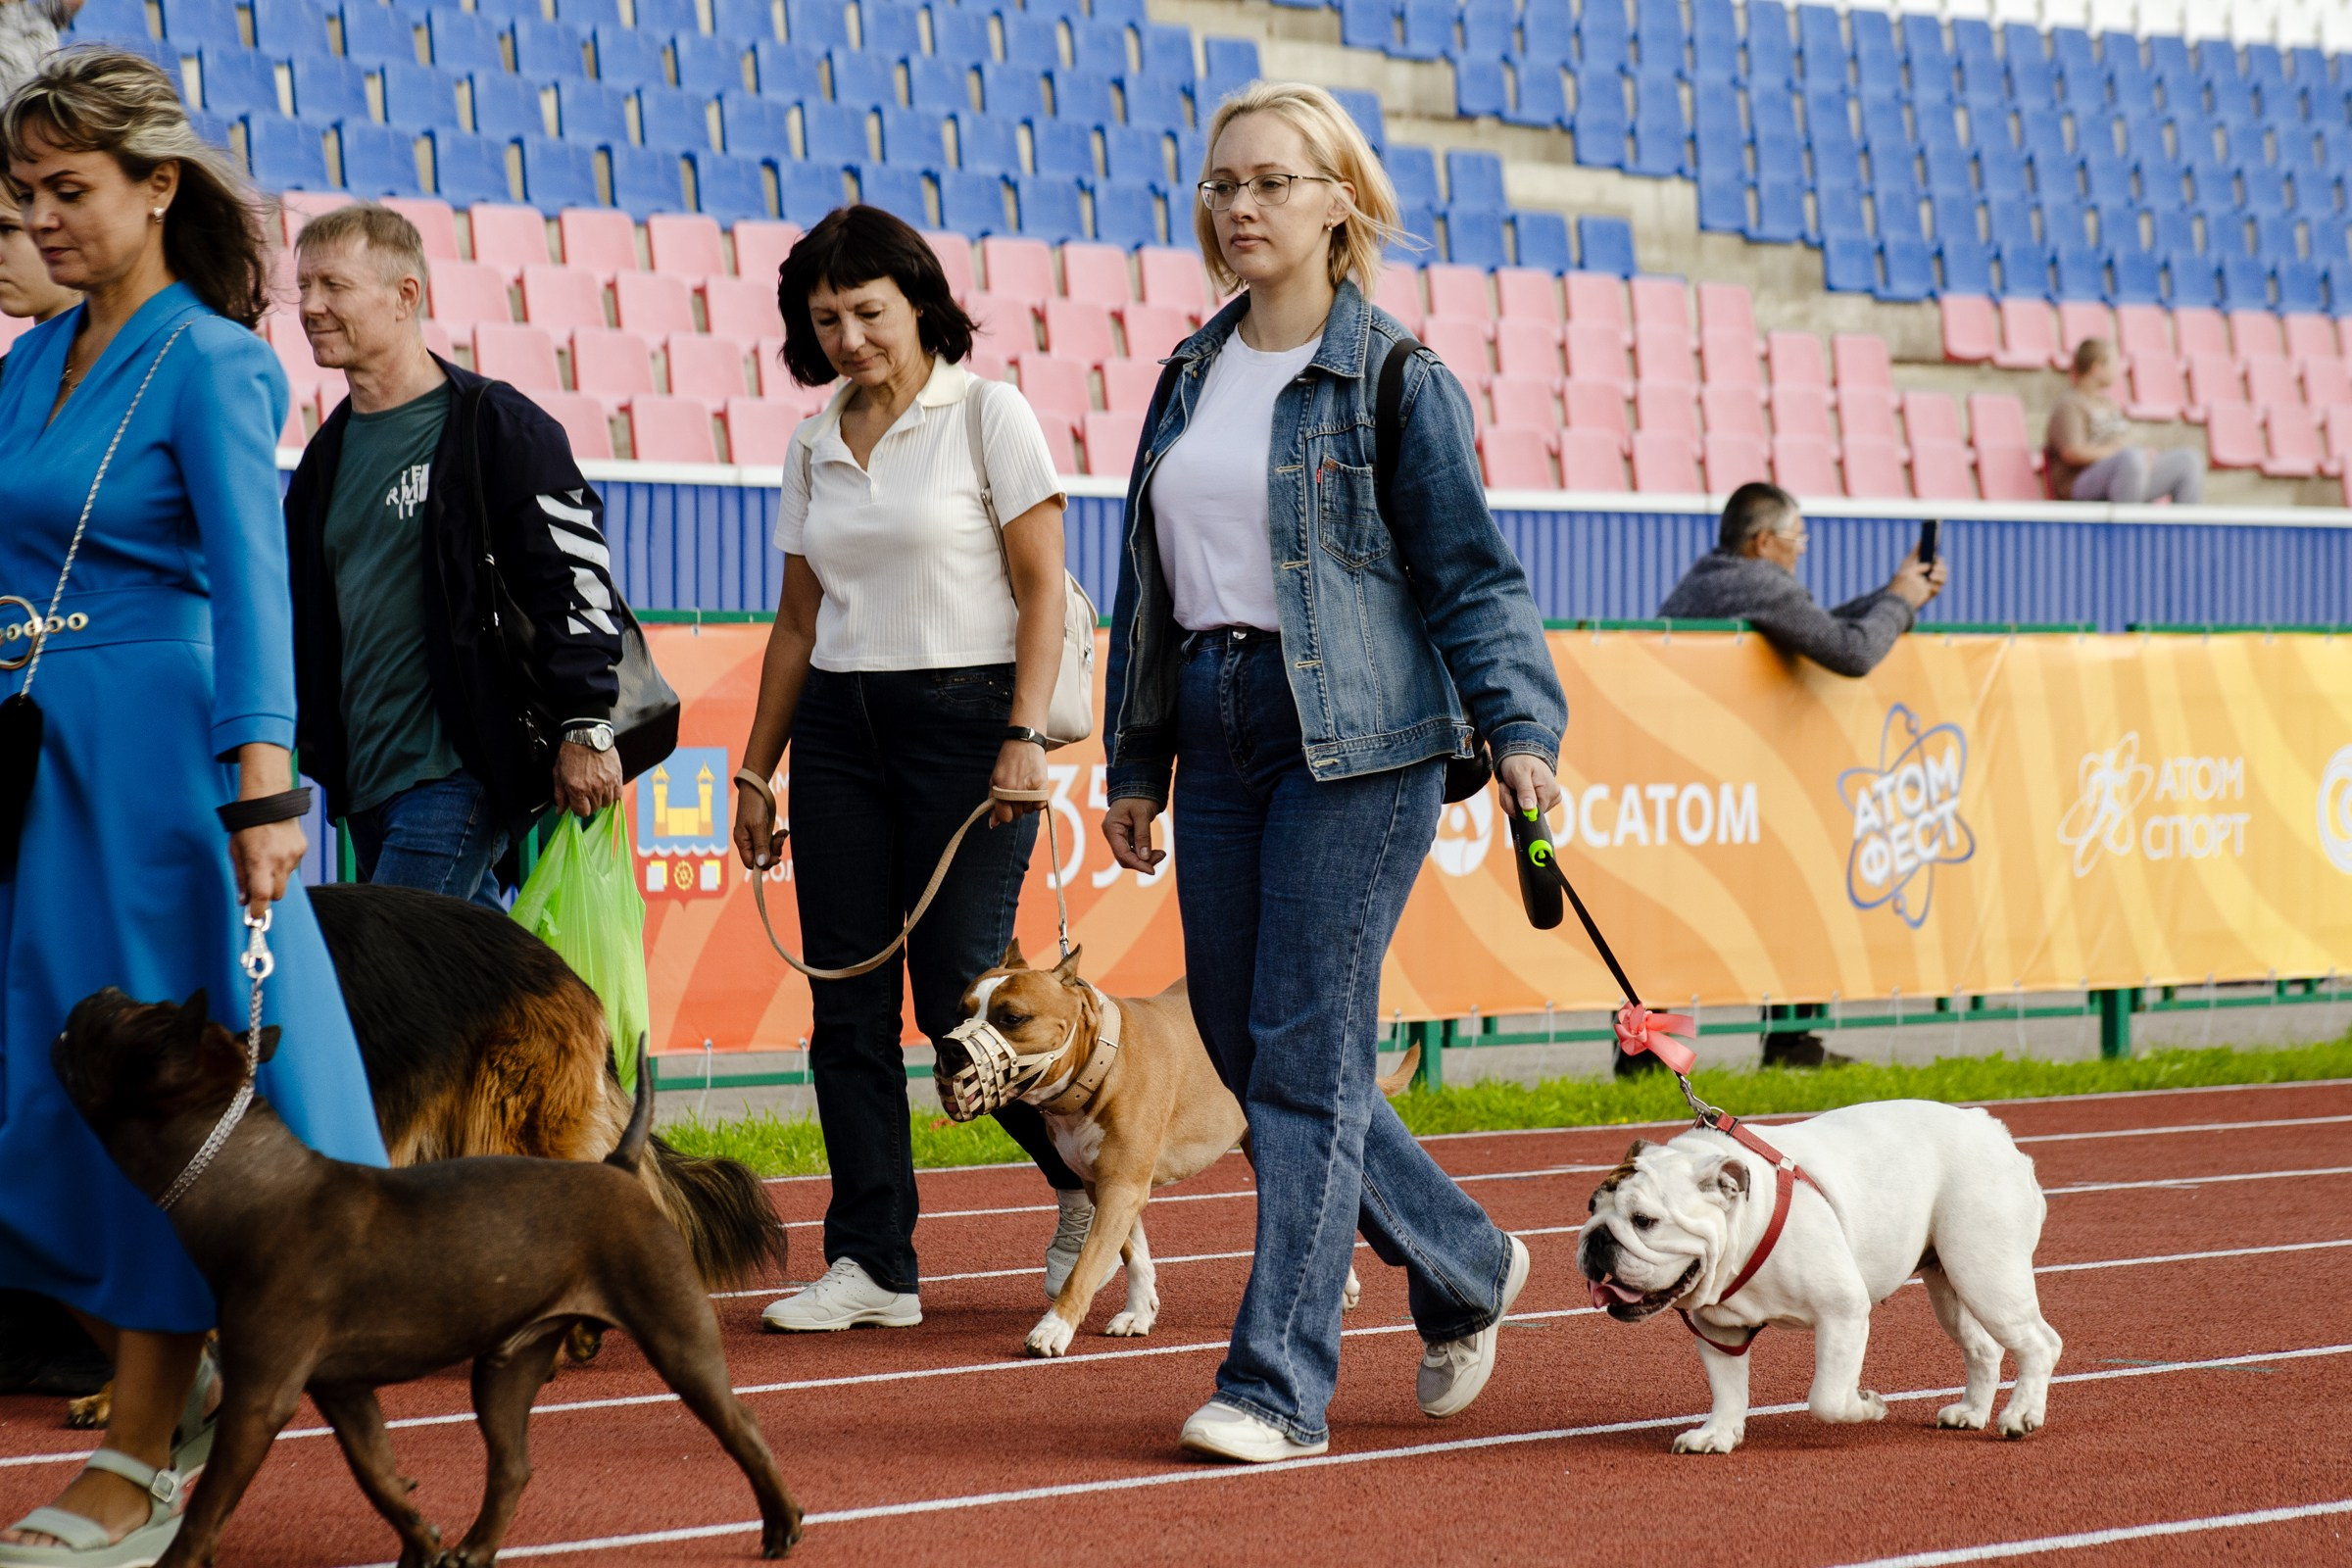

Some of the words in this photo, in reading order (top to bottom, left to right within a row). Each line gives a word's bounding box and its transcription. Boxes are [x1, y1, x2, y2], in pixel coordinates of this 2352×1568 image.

[1853, 745, 1960, 841] АТОМ
[2155, 756, 2244, 802] АТОМ
[1503, 781, 1761, 850] ОСАТОМ
[1858, 797, 1961, 888] ФЕСТ
[2142, 811, 2251, 860] СПОРТ
